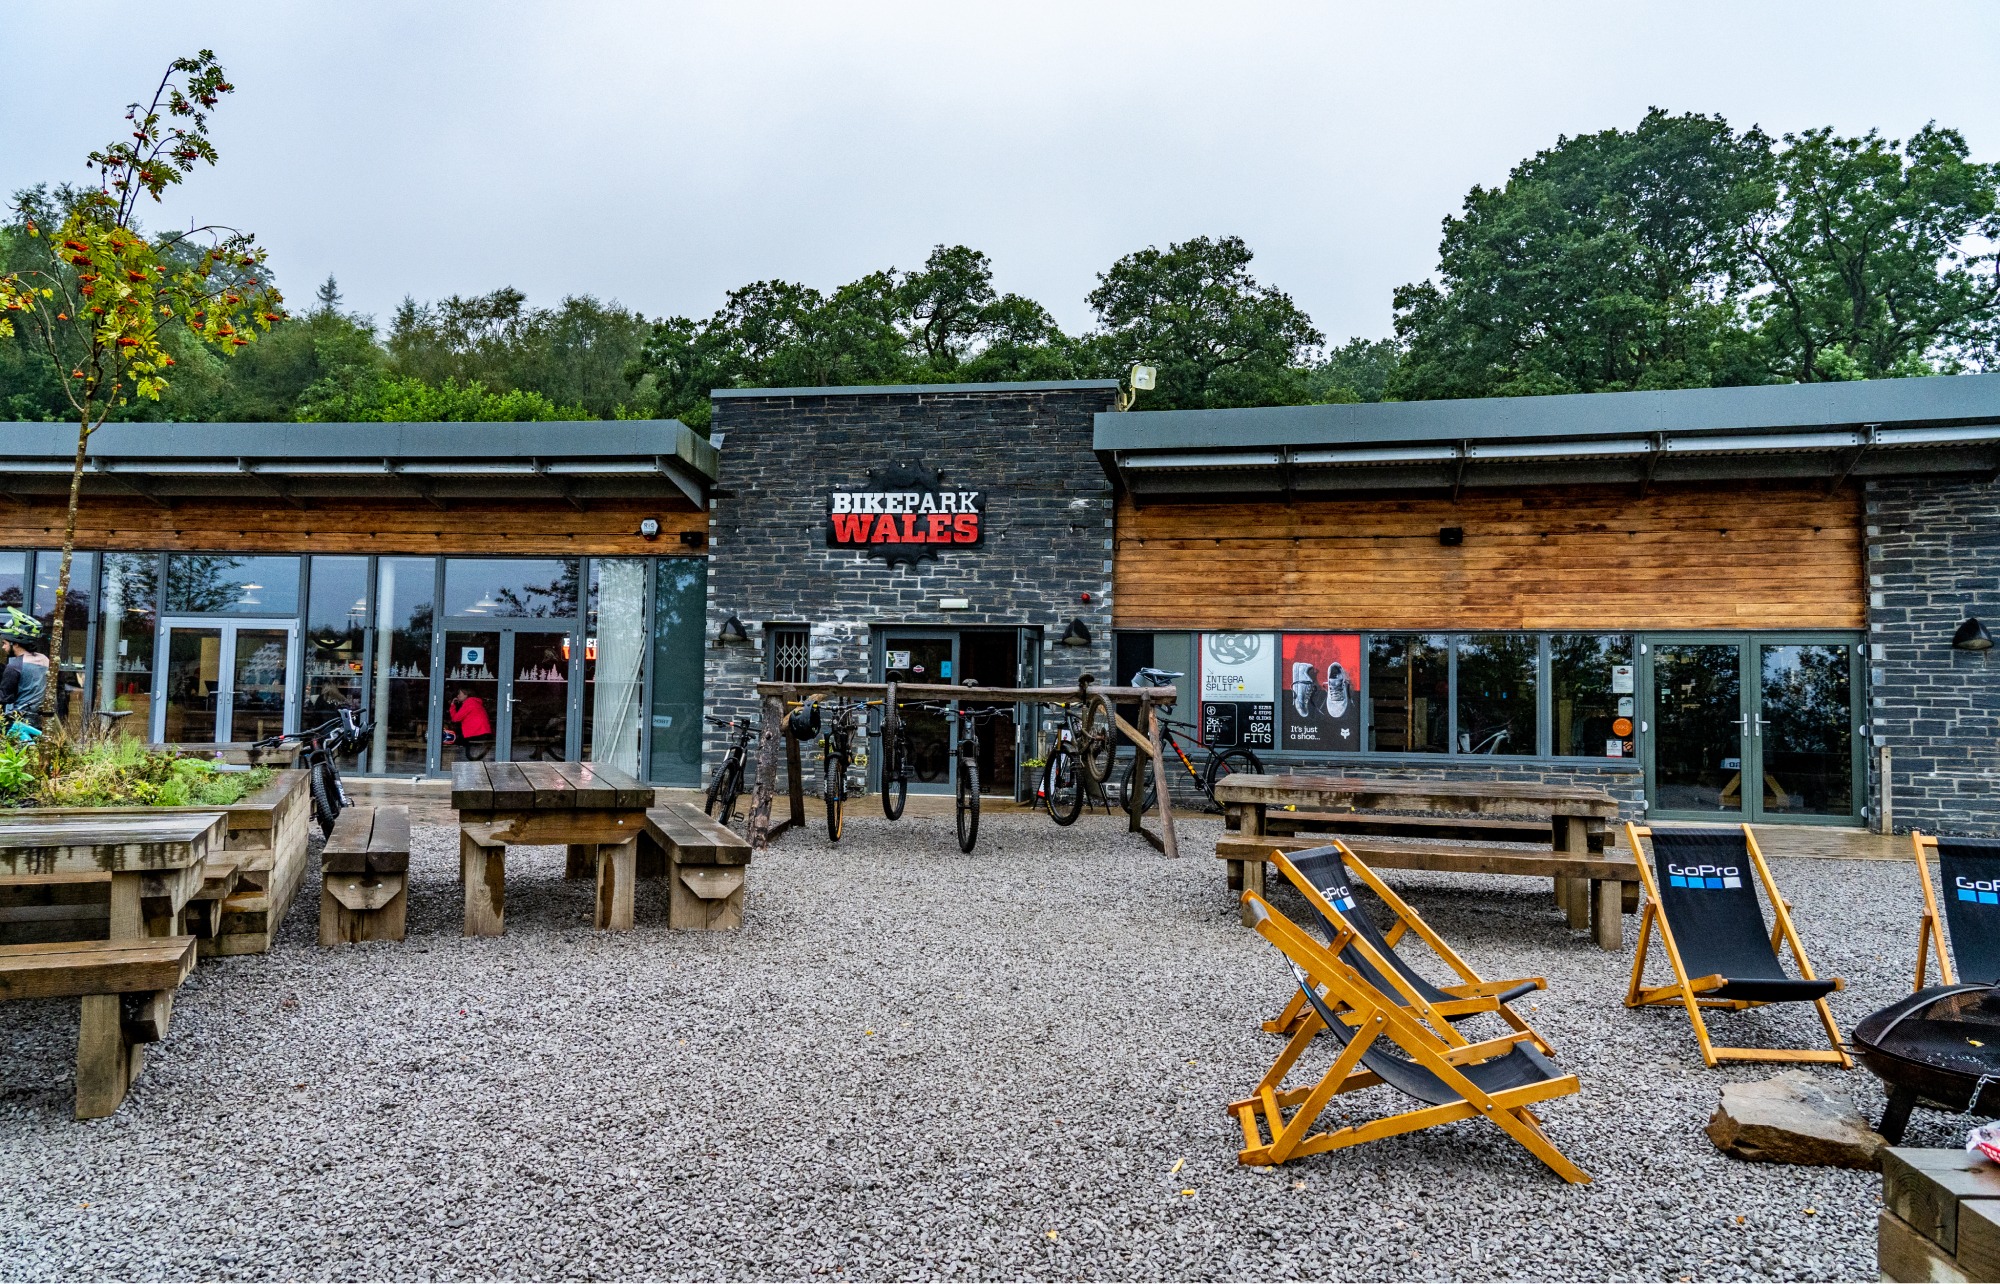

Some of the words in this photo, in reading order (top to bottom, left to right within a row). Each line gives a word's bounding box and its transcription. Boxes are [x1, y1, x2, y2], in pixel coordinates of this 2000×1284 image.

[832, 492, 979, 514] BIKEPARK
[831, 514, 979, 543] WALES
[1206, 675, 1244, 683] INTEGRA
[1205, 683, 1233, 691] SPLIT
[1250, 723, 1271, 732] 624
[1290, 725, 1303, 733] It's
[1304, 725, 1318, 734] just
[1243, 733, 1272, 743] FITS
[1668, 864, 1739, 876] GoPro
[1320, 886, 1350, 900] oPro
